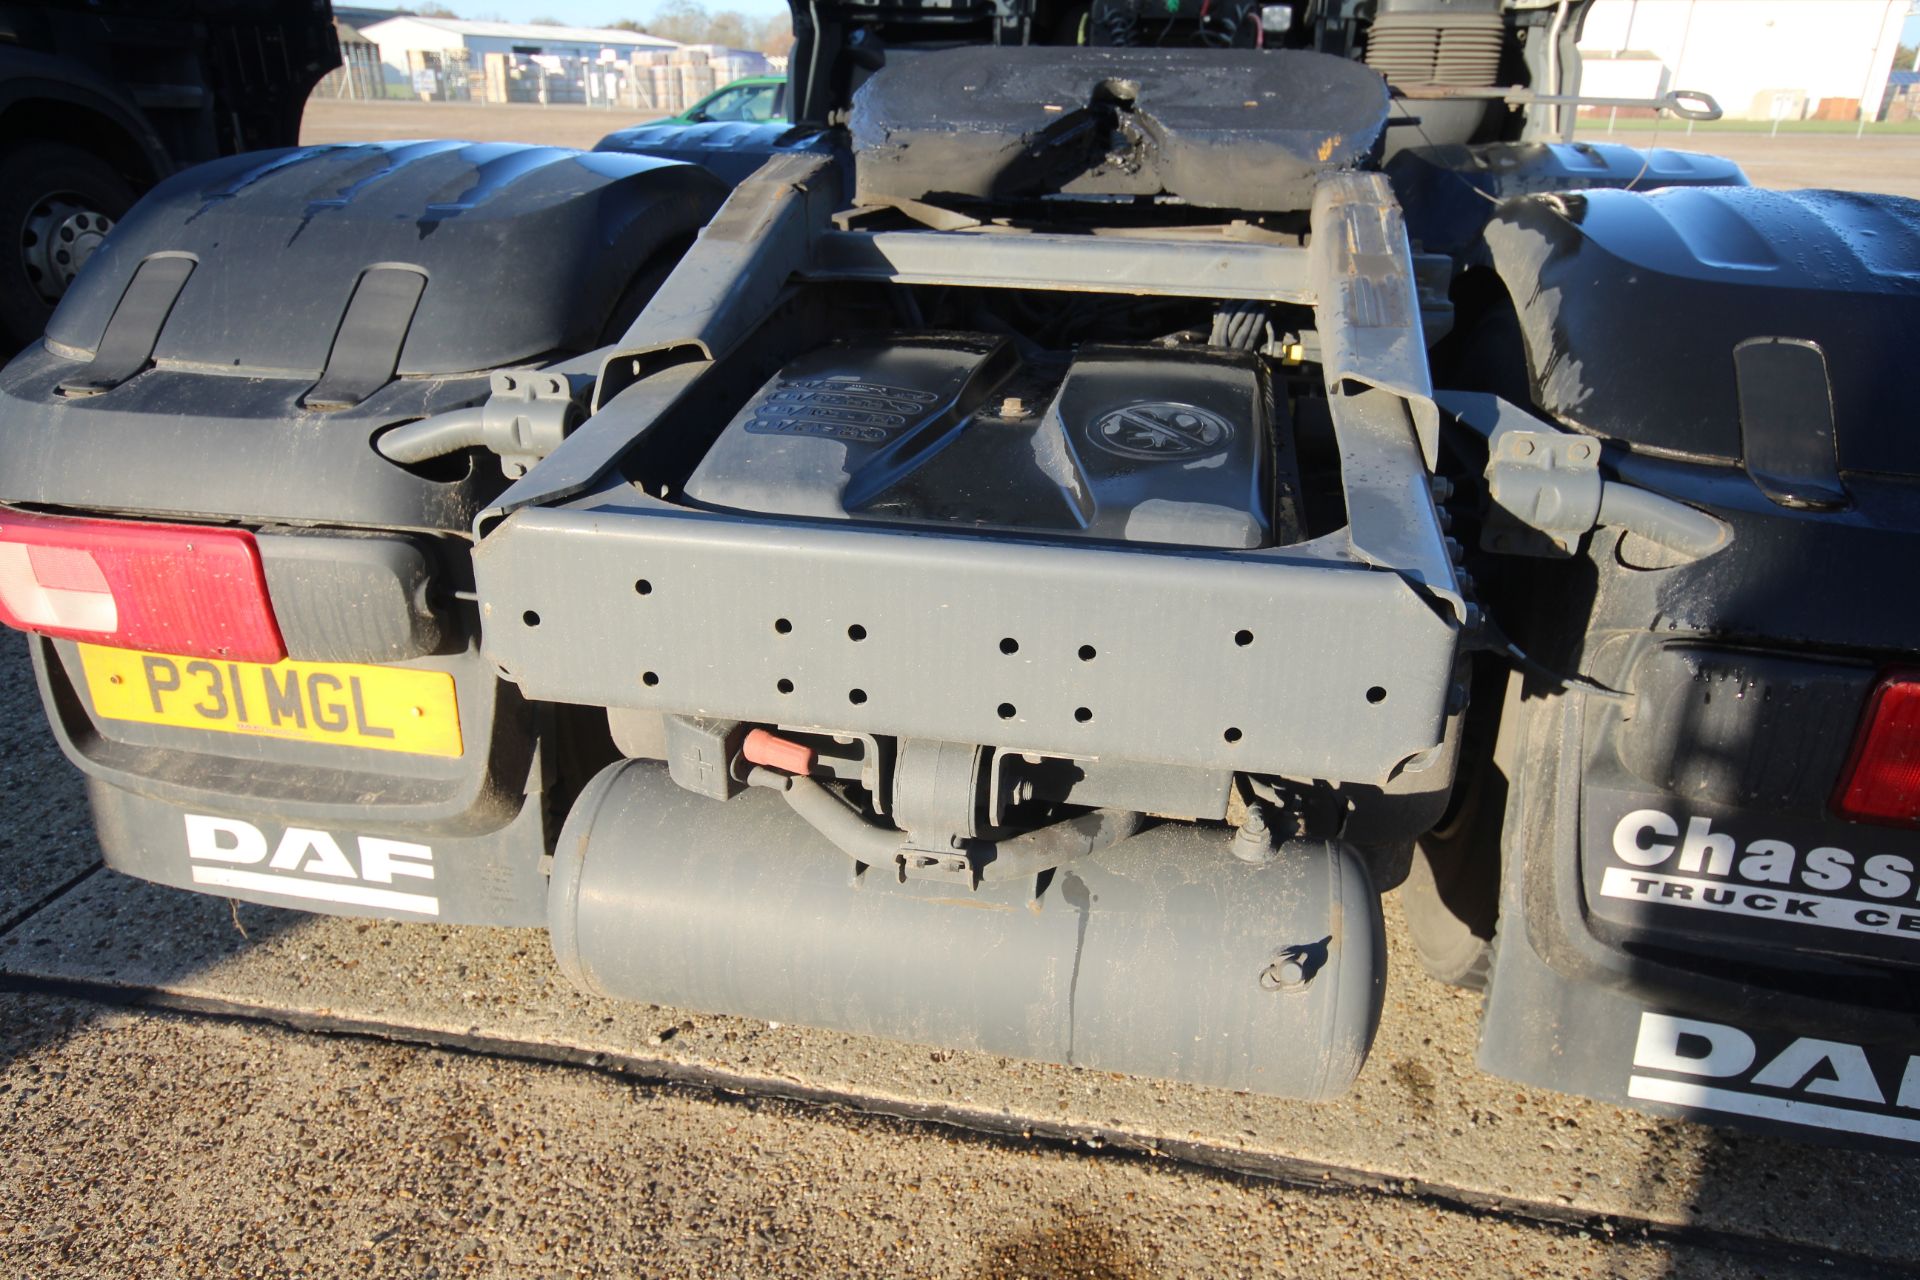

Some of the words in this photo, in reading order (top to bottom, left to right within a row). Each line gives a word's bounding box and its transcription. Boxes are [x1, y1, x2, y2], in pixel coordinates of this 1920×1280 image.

[141, 655, 249, 723] P31
[261, 666, 396, 739] MGL
[184, 813, 436, 884] DAF
[1612, 809, 1920, 902] Chass
[1630, 877, 1821, 918] TRUCK
